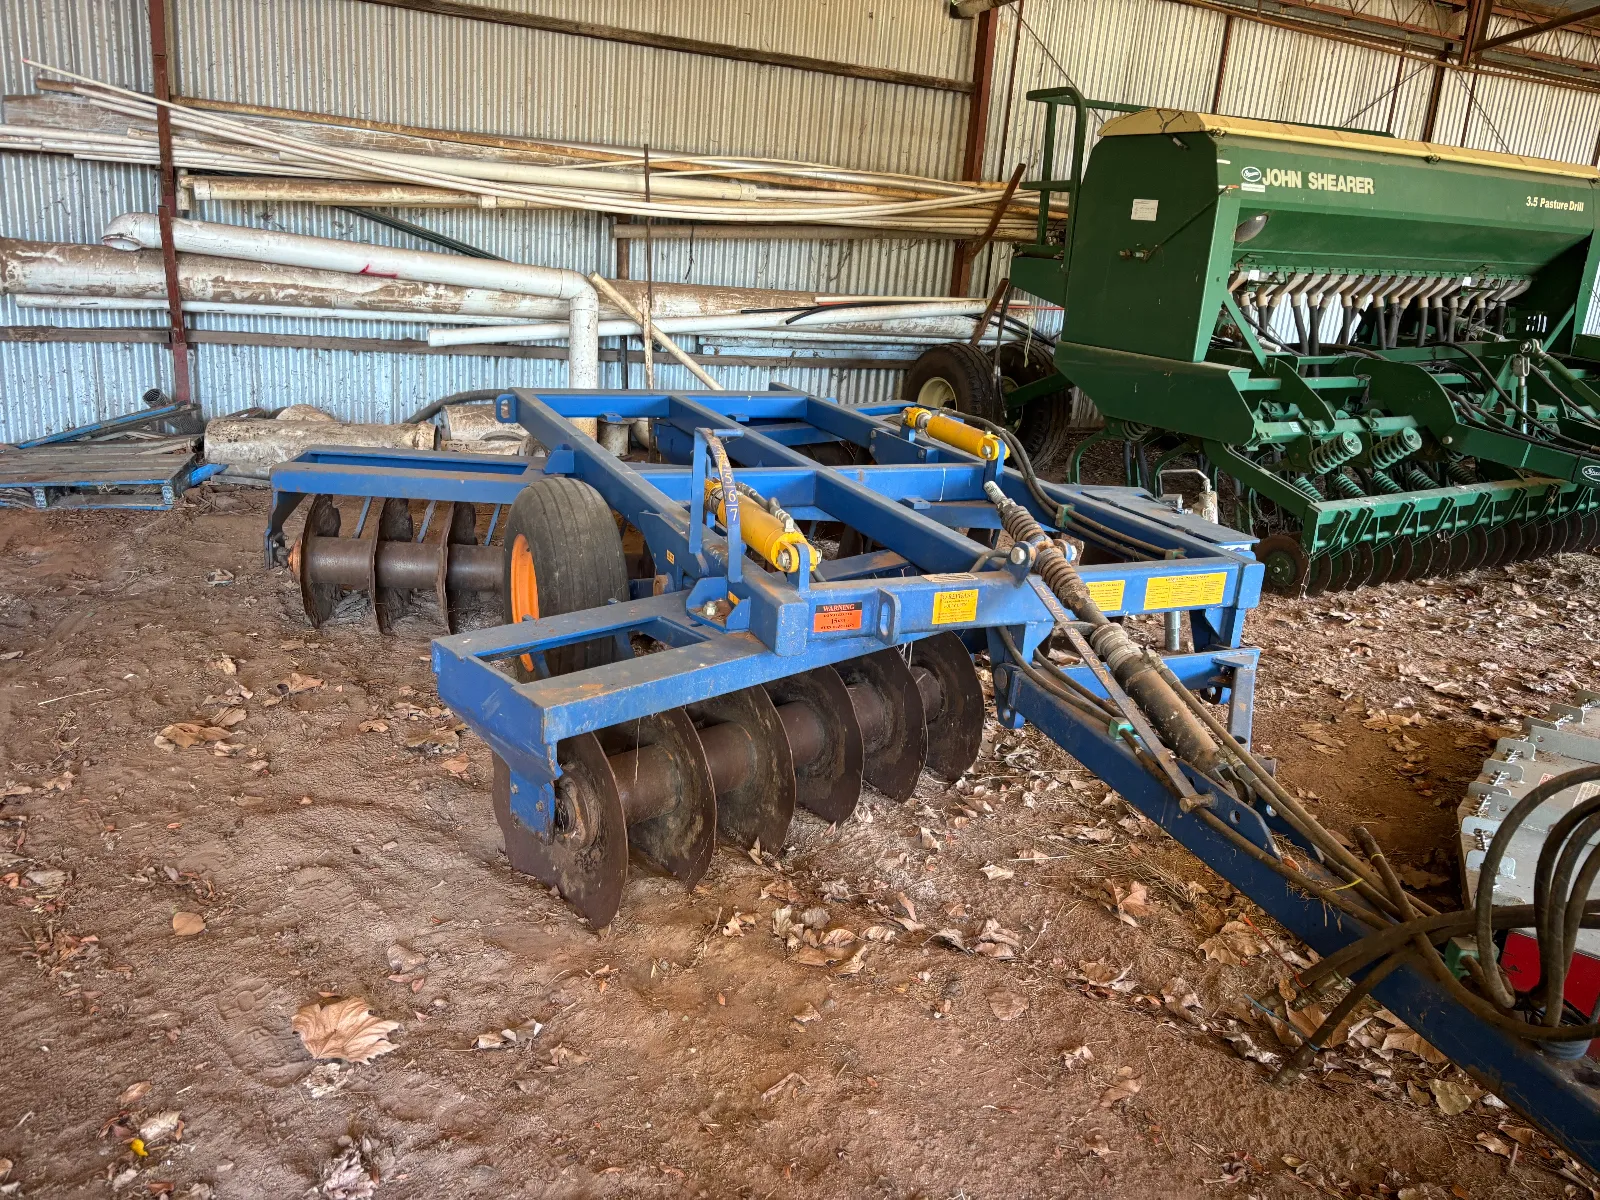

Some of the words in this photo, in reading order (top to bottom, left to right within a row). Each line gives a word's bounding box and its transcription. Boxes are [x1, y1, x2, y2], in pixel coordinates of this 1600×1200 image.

[1262, 168, 1302, 188] JOHN
[1308, 171, 1375, 194] SHEARER
[1526, 195, 1539, 207] 3.5
[1540, 197, 1569, 210] Pasture
[1569, 200, 1585, 212] Drill
[725, 472, 733, 484] 5
[728, 489, 737, 503] 6
[730, 508, 738, 521] 7
[823, 603, 855, 612] WARNING
